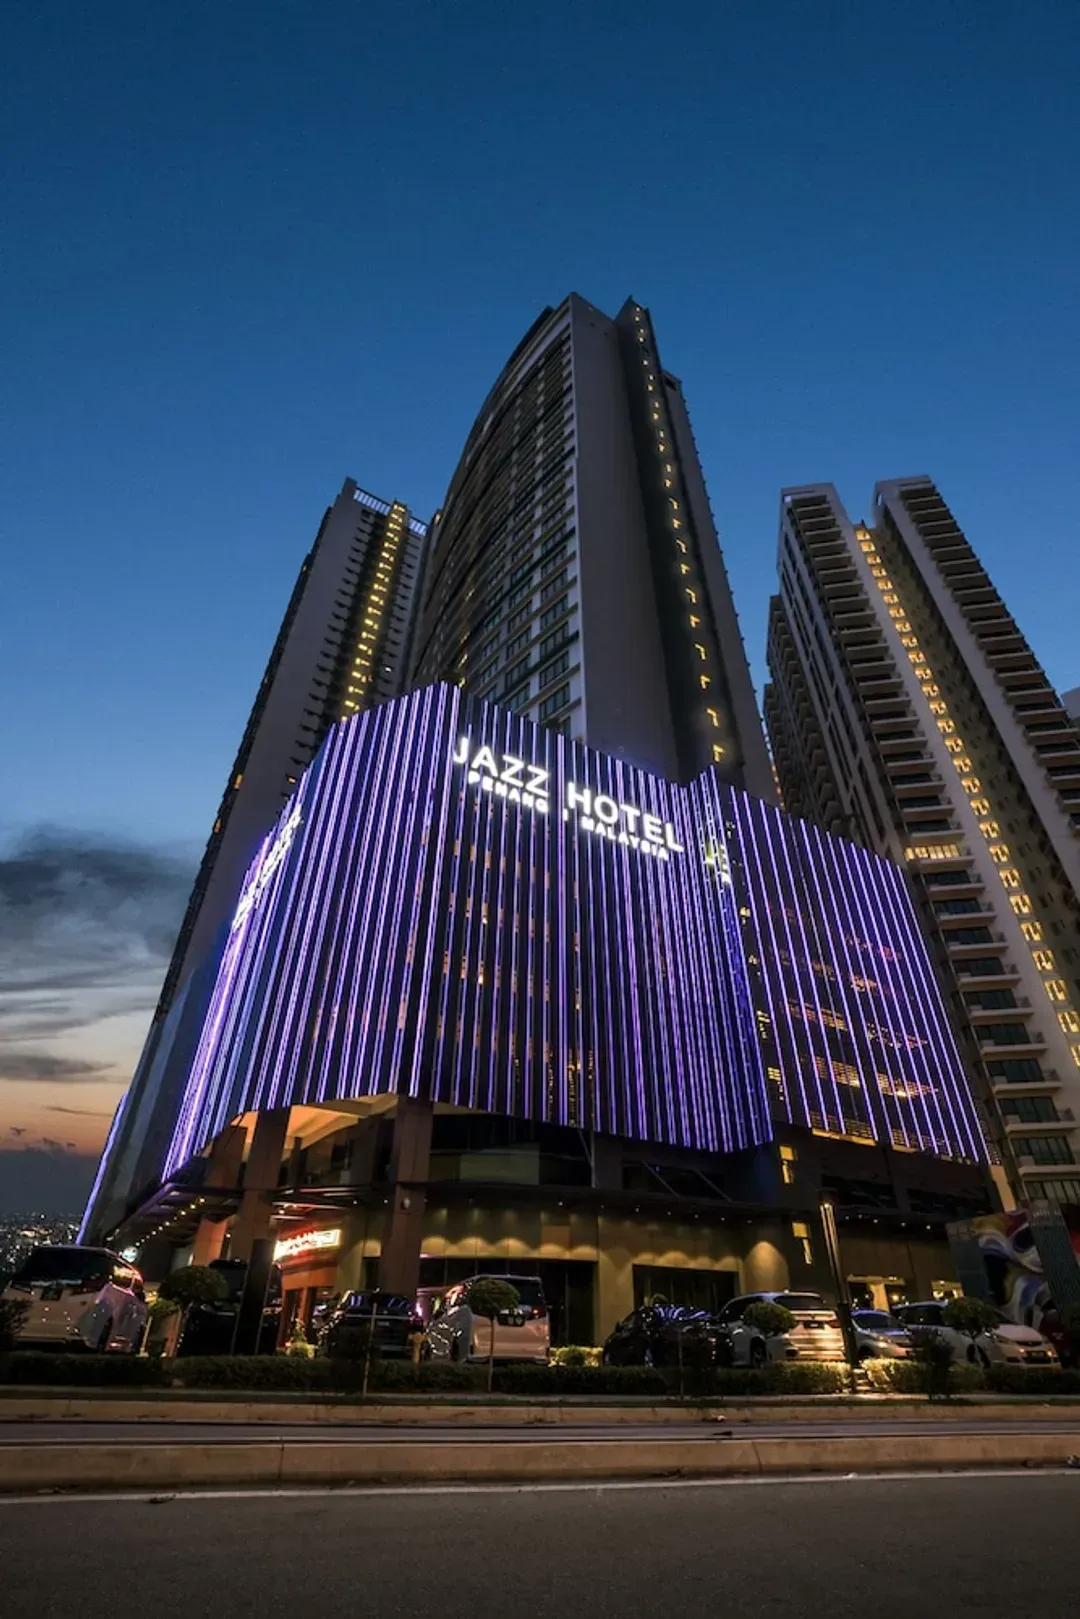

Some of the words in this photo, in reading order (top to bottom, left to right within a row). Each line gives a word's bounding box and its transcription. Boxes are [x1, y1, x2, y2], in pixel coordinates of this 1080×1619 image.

[453, 737, 549, 798] JAZZ
[567, 781, 685, 853] HOTEL
[467, 770, 549, 814] PENANG
[580, 815, 669, 861] MALAYSIA
